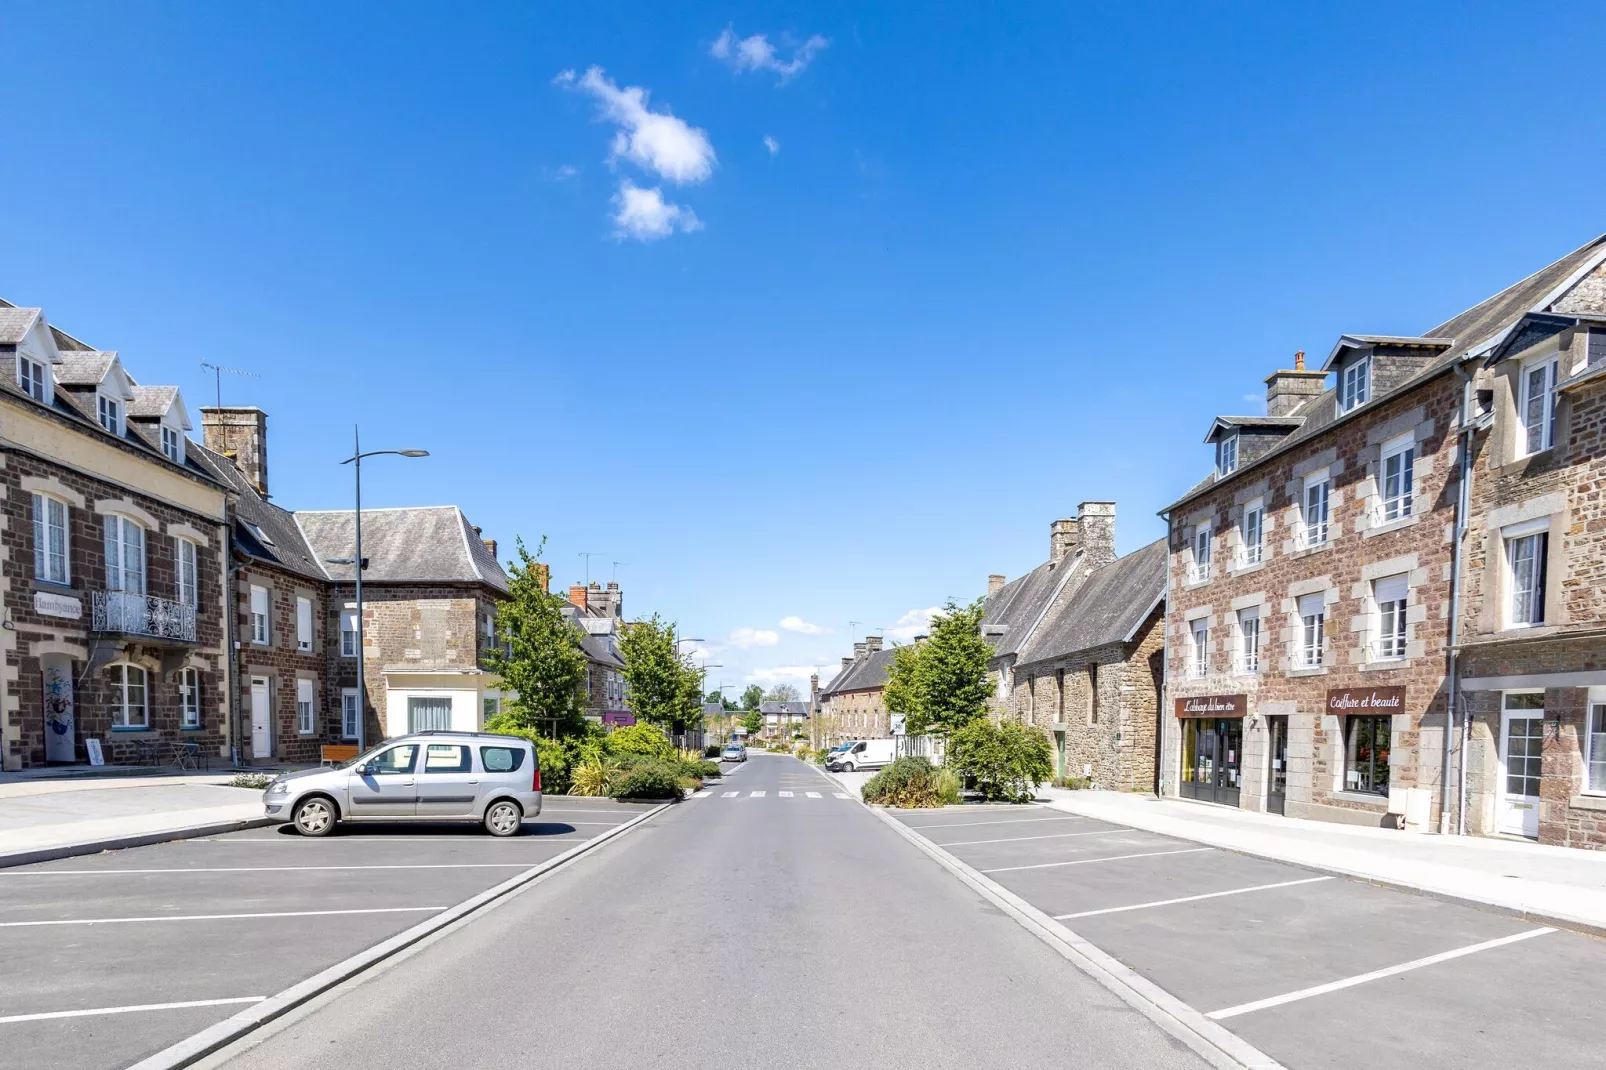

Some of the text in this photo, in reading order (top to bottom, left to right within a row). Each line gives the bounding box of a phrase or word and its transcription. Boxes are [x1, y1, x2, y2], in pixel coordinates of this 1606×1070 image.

[1208, 697, 1215, 711] du
[1215, 697, 1225, 711] bien
[1330, 692, 1400, 709] Coiffure et beauté
